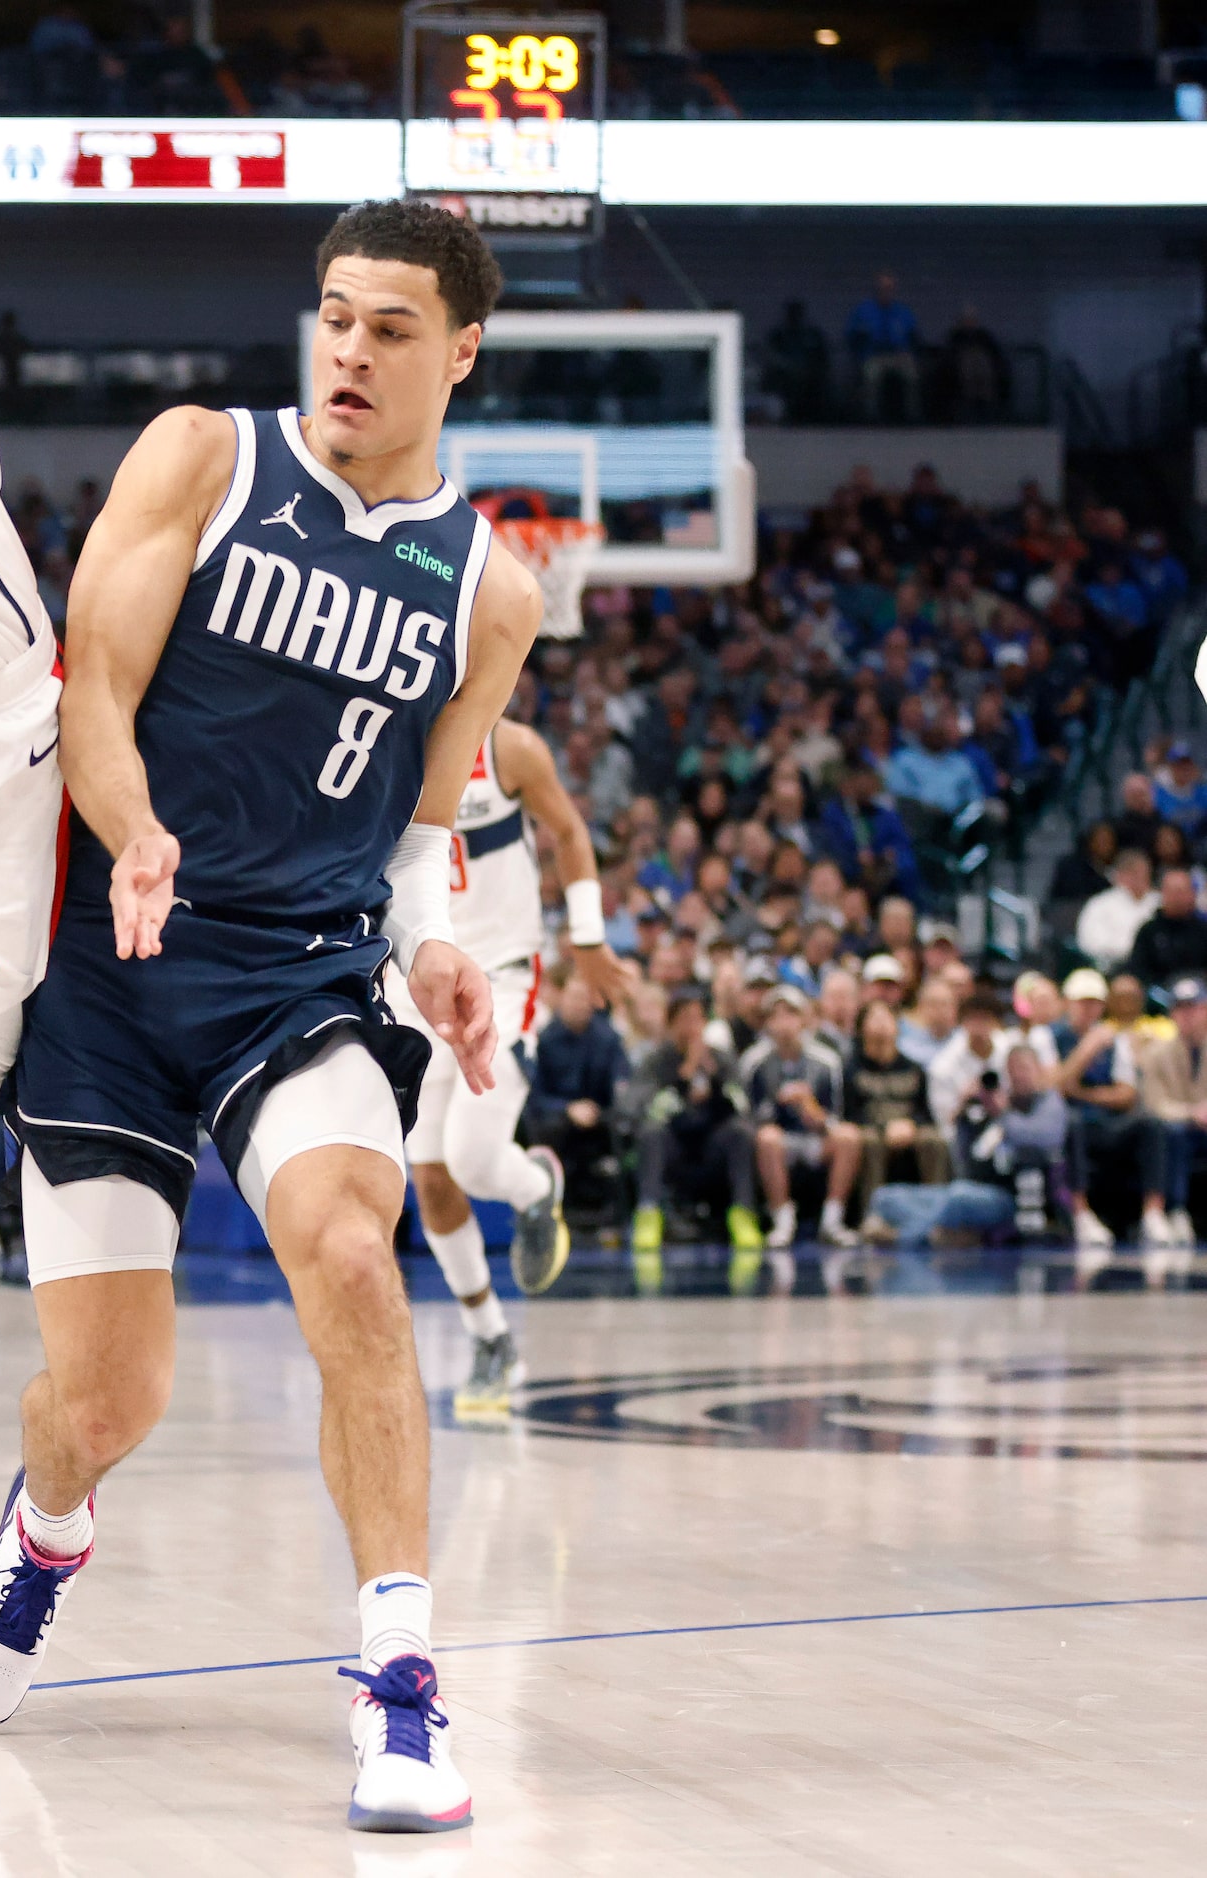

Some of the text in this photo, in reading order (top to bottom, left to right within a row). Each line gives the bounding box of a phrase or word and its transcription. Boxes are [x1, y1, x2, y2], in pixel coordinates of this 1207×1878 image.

[465, 34, 579, 92] 3:09
[466, 195, 590, 226] TISSOT
[395, 542, 454, 582] chime
[207, 542, 448, 701] MAVS
[317, 697, 393, 799] 8
